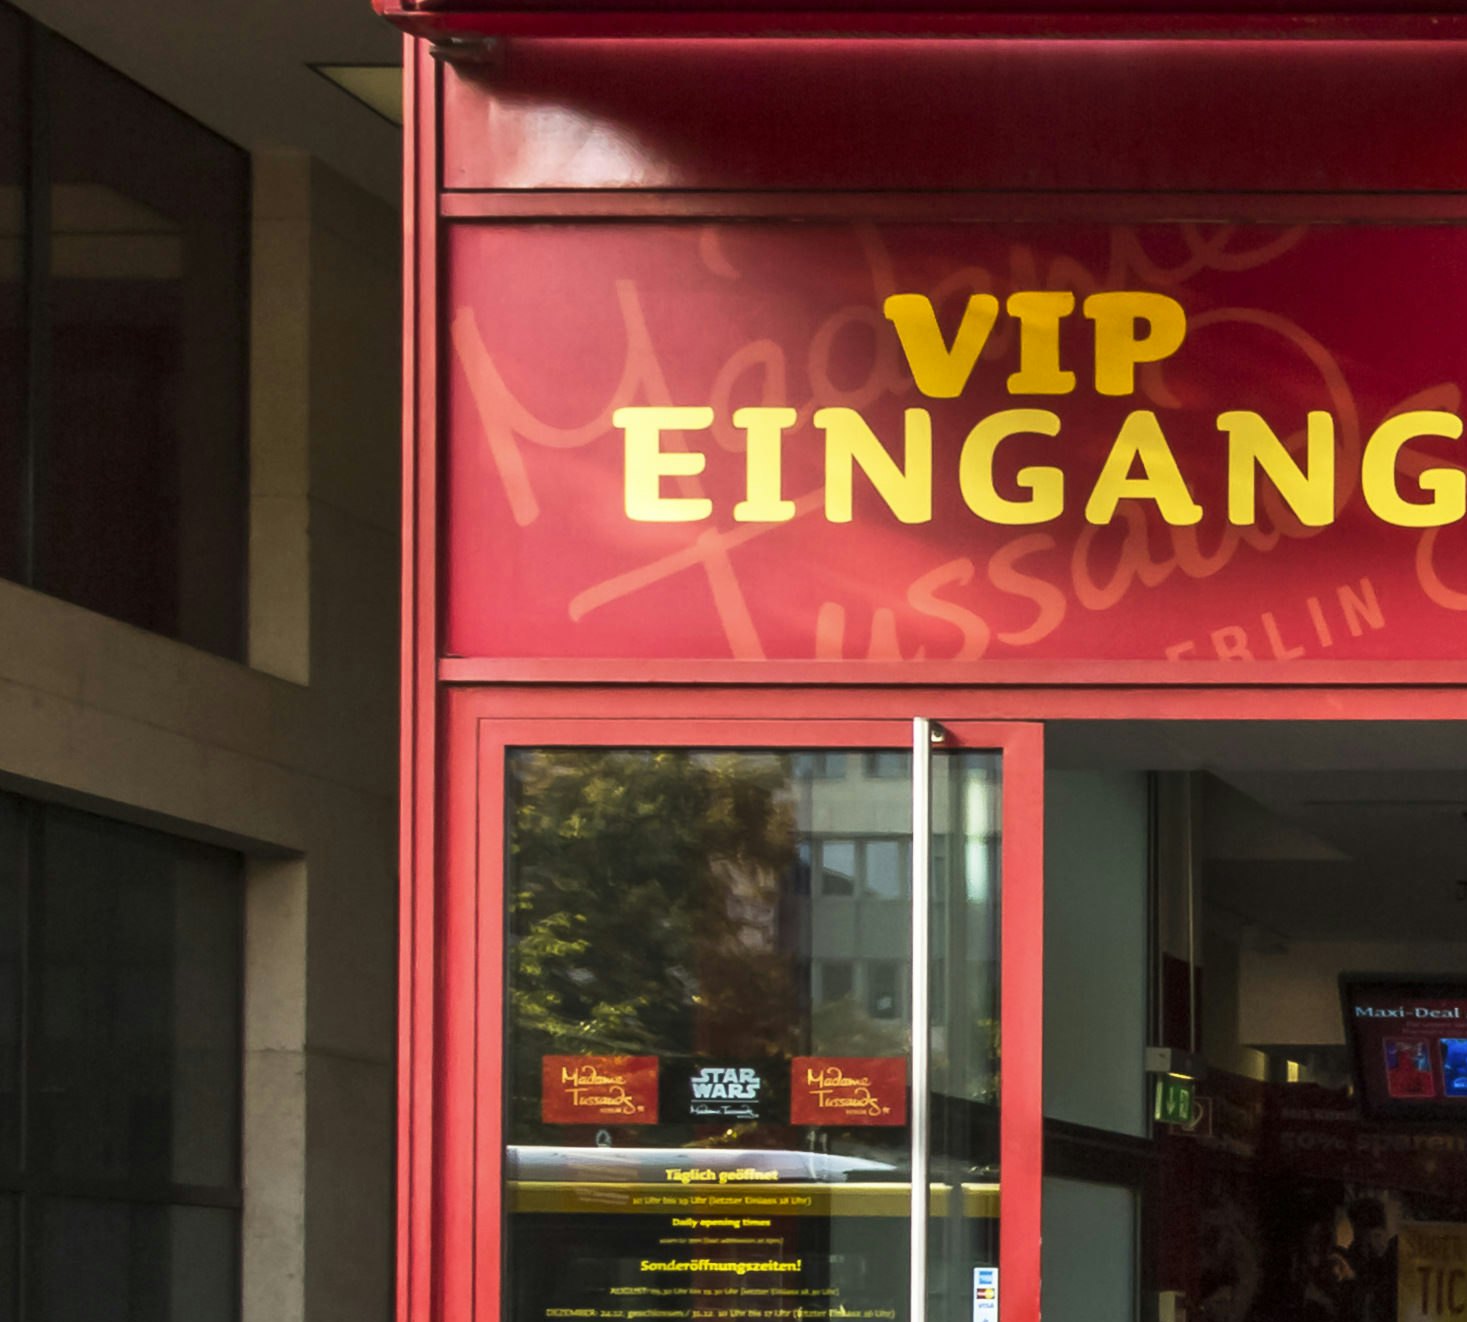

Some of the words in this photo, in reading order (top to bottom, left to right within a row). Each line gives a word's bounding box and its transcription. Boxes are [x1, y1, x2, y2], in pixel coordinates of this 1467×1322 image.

[883, 291, 1187, 398] VIP
[612, 405, 1467, 527] EINGANG
[1165, 577, 1389, 661] ERLIN
[1355, 1006, 1460, 1019] Maxi-Deal
[690, 1067, 760, 1084] STAR
[691, 1083, 760, 1099] WARS
[665, 1169, 716, 1184] Täglich
[718, 1169, 779, 1184] geöffnet
[672, 1218, 697, 1228] Daily
[700, 1219, 741, 1229] opening
[743, 1218, 771, 1227] times
[640, 1259, 802, 1275] Sonderöffnungszeiten!
